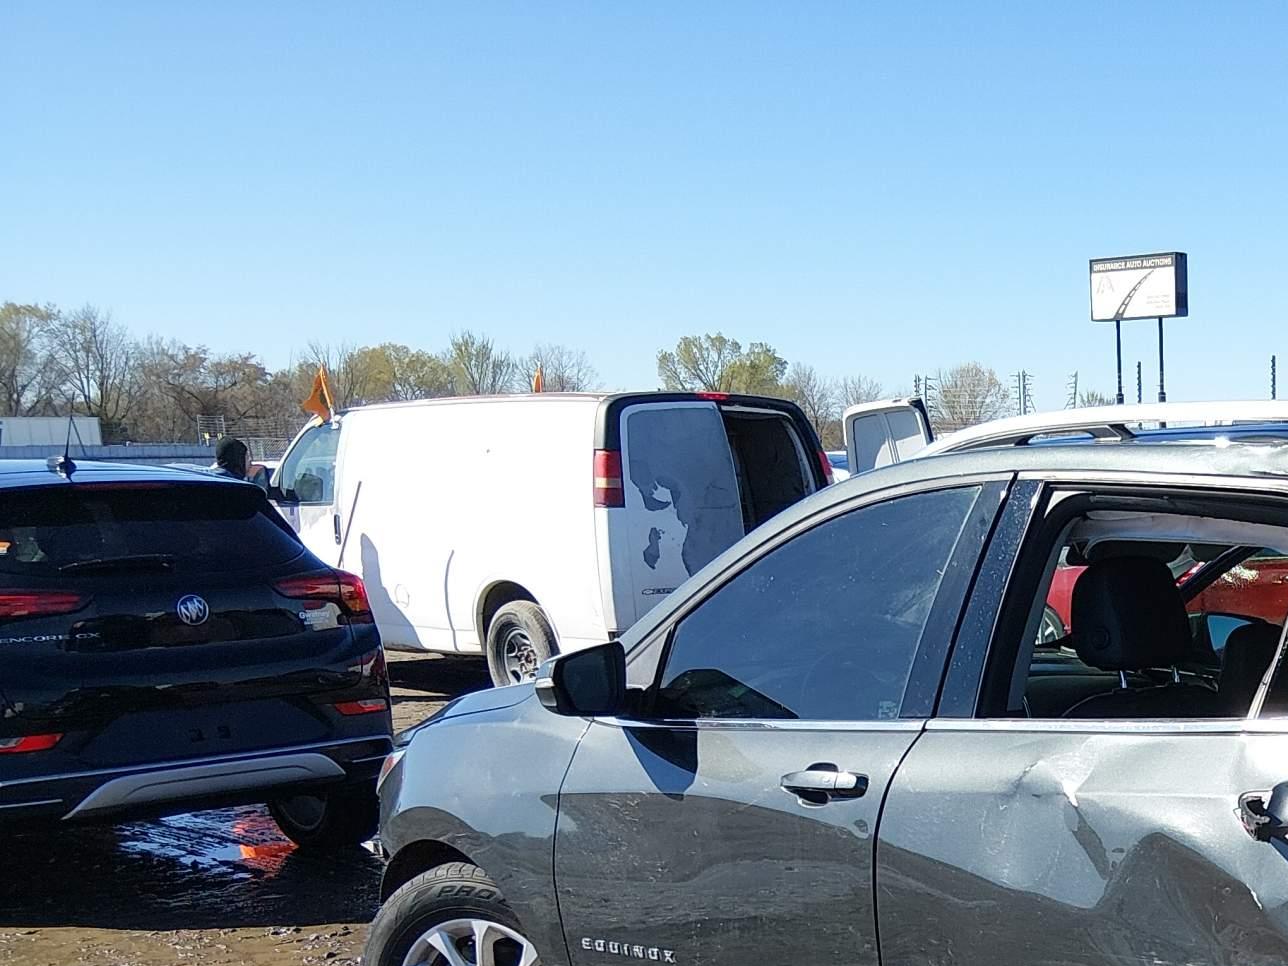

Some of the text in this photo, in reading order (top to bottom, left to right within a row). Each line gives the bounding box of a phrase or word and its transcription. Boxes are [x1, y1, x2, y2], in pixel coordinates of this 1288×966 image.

[1093, 257, 1172, 272] INSURANCE AUTO AUCTIONS
[580, 936, 677, 963] EQUINOX
